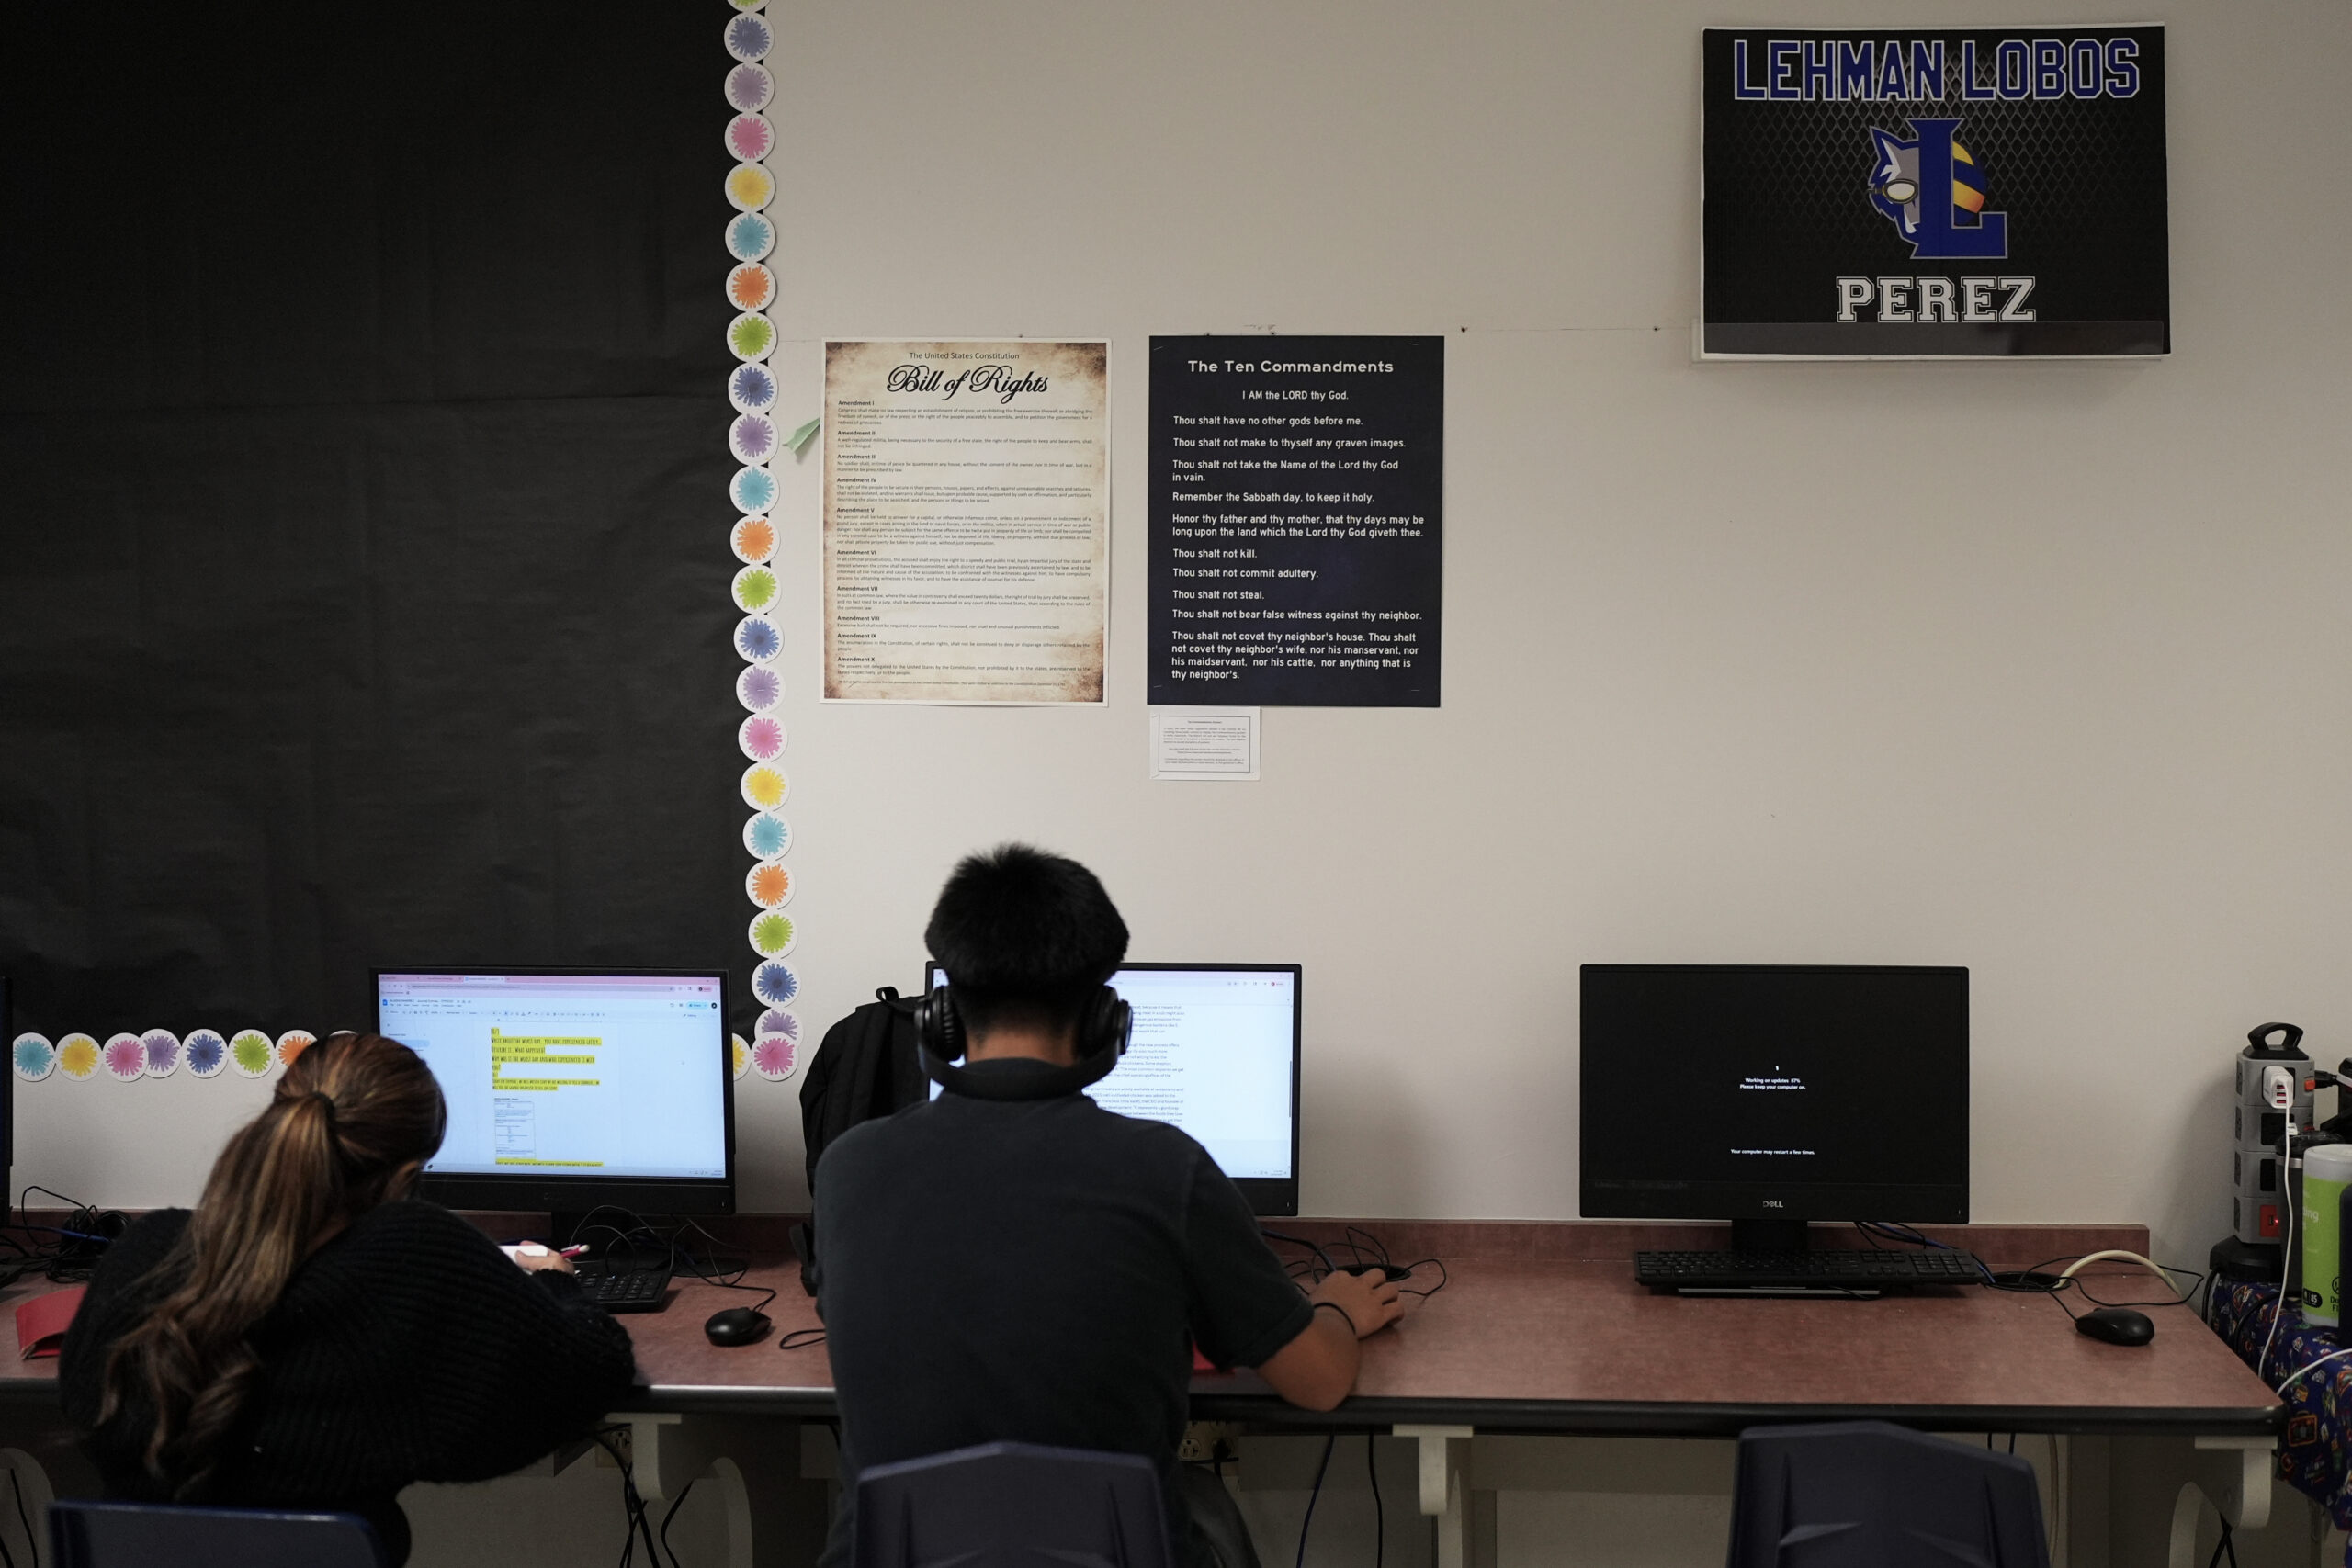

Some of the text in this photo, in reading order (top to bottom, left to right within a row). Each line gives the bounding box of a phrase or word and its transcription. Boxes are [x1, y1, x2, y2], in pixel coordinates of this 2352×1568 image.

[1734, 38, 2140, 102] LEHMAN LOBOS
[1836, 276, 2036, 323] PEREZ
[924, 352, 949, 360] United
[974, 352, 1020, 360] Constitution
[1187, 360, 1394, 373] The Ten Commandments
[887, 365, 1048, 405] Bill of Rights
[1242, 390, 1349, 402] I AM the LORD thy God.
[1173, 415, 1195, 425] Thou
[1198, 415, 1221, 425] shalt
[1223, 416, 1246, 425] have
[1261, 416, 1286, 425] other
[1289, 416, 1311, 427] gods
[1314, 416, 1343, 425] before
[1173, 437, 1406, 450] Thou shalt not make to thyself any graven images.
[1172, 459, 1398, 472] Thou shalt not take the Name of the Lord thy God
[1172, 472, 1205, 482] in vain.
[1172, 491, 1223, 502] Remember
[1226, 492, 1240, 502] the
[1243, 492, 1281, 502] Sabbath
[1306, 492, 1316, 502] to
[1317, 492, 1340, 504] keep
[1343, 492, 1350, 502] it
[1351, 492, 1374, 504] holy.
[1172, 513, 1200, 524] Honor
[1202, 514, 1217, 526] thy
[1220, 513, 1248, 524] father
[1250, 514, 1267, 524] and
[1269, 514, 1285, 526] thy
[1325, 514, 1344, 524] that
[1346, 514, 1362, 526] thy
[1364, 514, 1387, 526] days
[1389, 516, 1410, 526] may
[1412, 515, 1424, 525] be
[1172, 526, 1423, 539] long upon the land which the Lord thy God giveth thee.
[1172, 548, 1257, 558] Thou shalt not kill.
[1172, 568, 1318, 581] Thou shalt not commit adultery.
[1172, 590, 1264, 600] Thou shalt not steal.
[1172, 609, 1422, 622] Thou shalt not bear false witness against thy neighbor.
[1172, 631, 1416, 644] Thou shalt not covet thy neighbor's house. Thou shalt
[1171, 644, 1187, 653] not
[1189, 644, 1215, 653] covet
[1217, 644, 1233, 656] thy
[1235, 644, 1283, 656] neighbor's
[1328, 645, 1341, 654] his
[1171, 657, 1185, 666] his
[1252, 659, 1268, 667] nor
[1271, 658, 1284, 667] his
[1339, 658, 1379, 670] anything
[1382, 659, 1400, 668] that
[1403, 659, 1411, 668] is
[1171, 670, 1239, 682] thy neighbor's.
[1762, 1200, 1784, 1208] DELL
